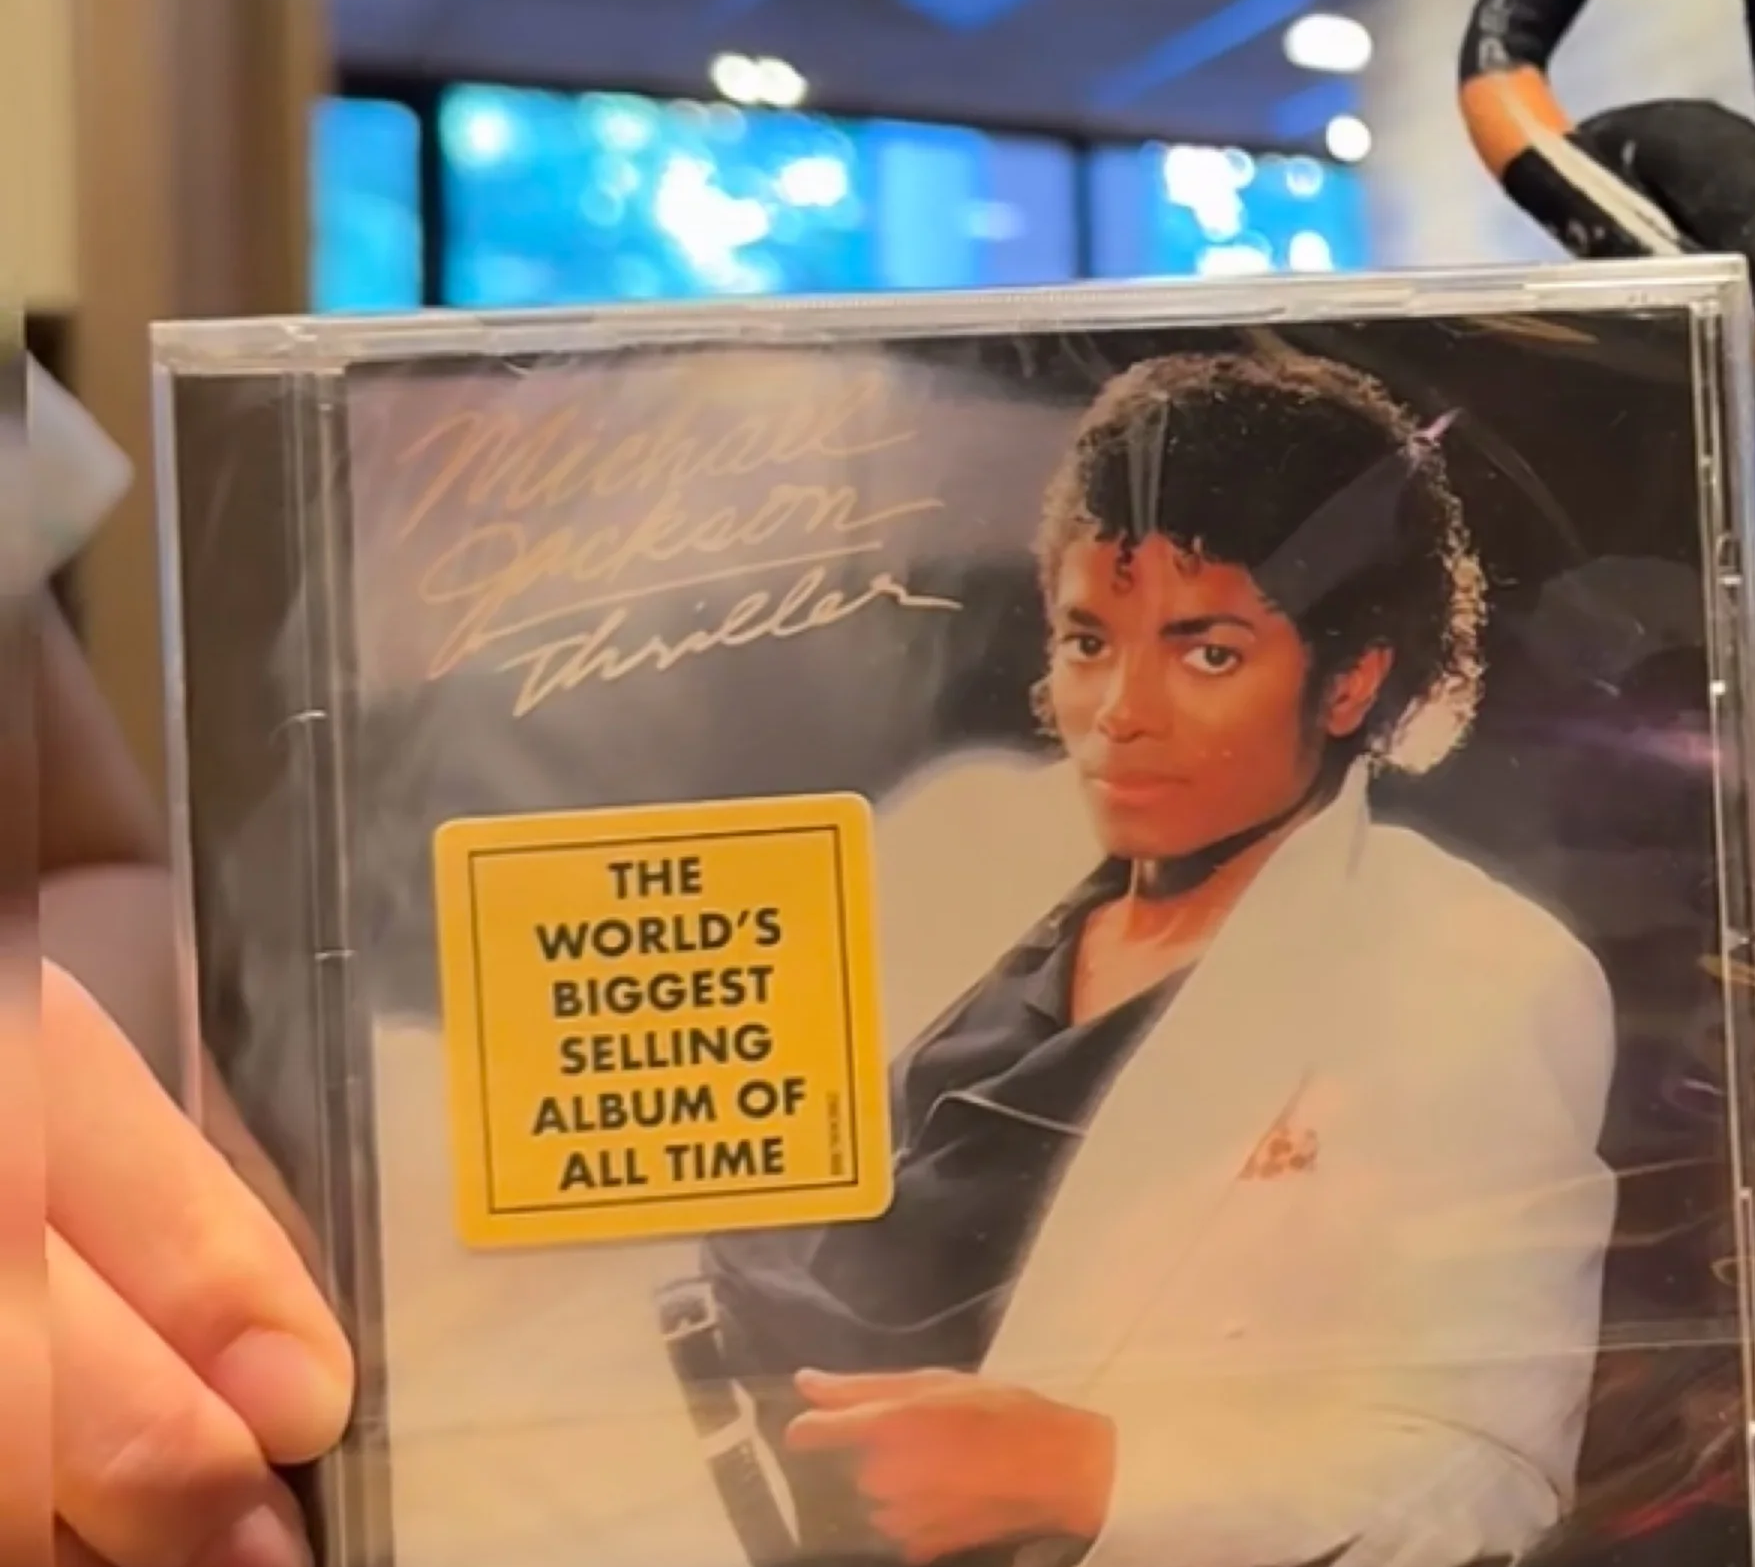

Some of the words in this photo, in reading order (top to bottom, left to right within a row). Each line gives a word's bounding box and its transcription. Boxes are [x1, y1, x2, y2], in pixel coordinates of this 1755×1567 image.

[400, 373, 918, 539] Michael
[416, 476, 945, 683] Jackson
[498, 563, 963, 719] Thriller
[608, 856, 703, 900] THE
[535, 907, 782, 962] WORLD'S
[552, 965, 774, 1018] BIGGEST
[560, 1023, 773, 1075] SELLING
[531, 1083, 717, 1136] ALBUM
[737, 1078, 806, 1120] OF
[559, 1147, 648, 1191] ALL
[665, 1137, 785, 1183] TIME
